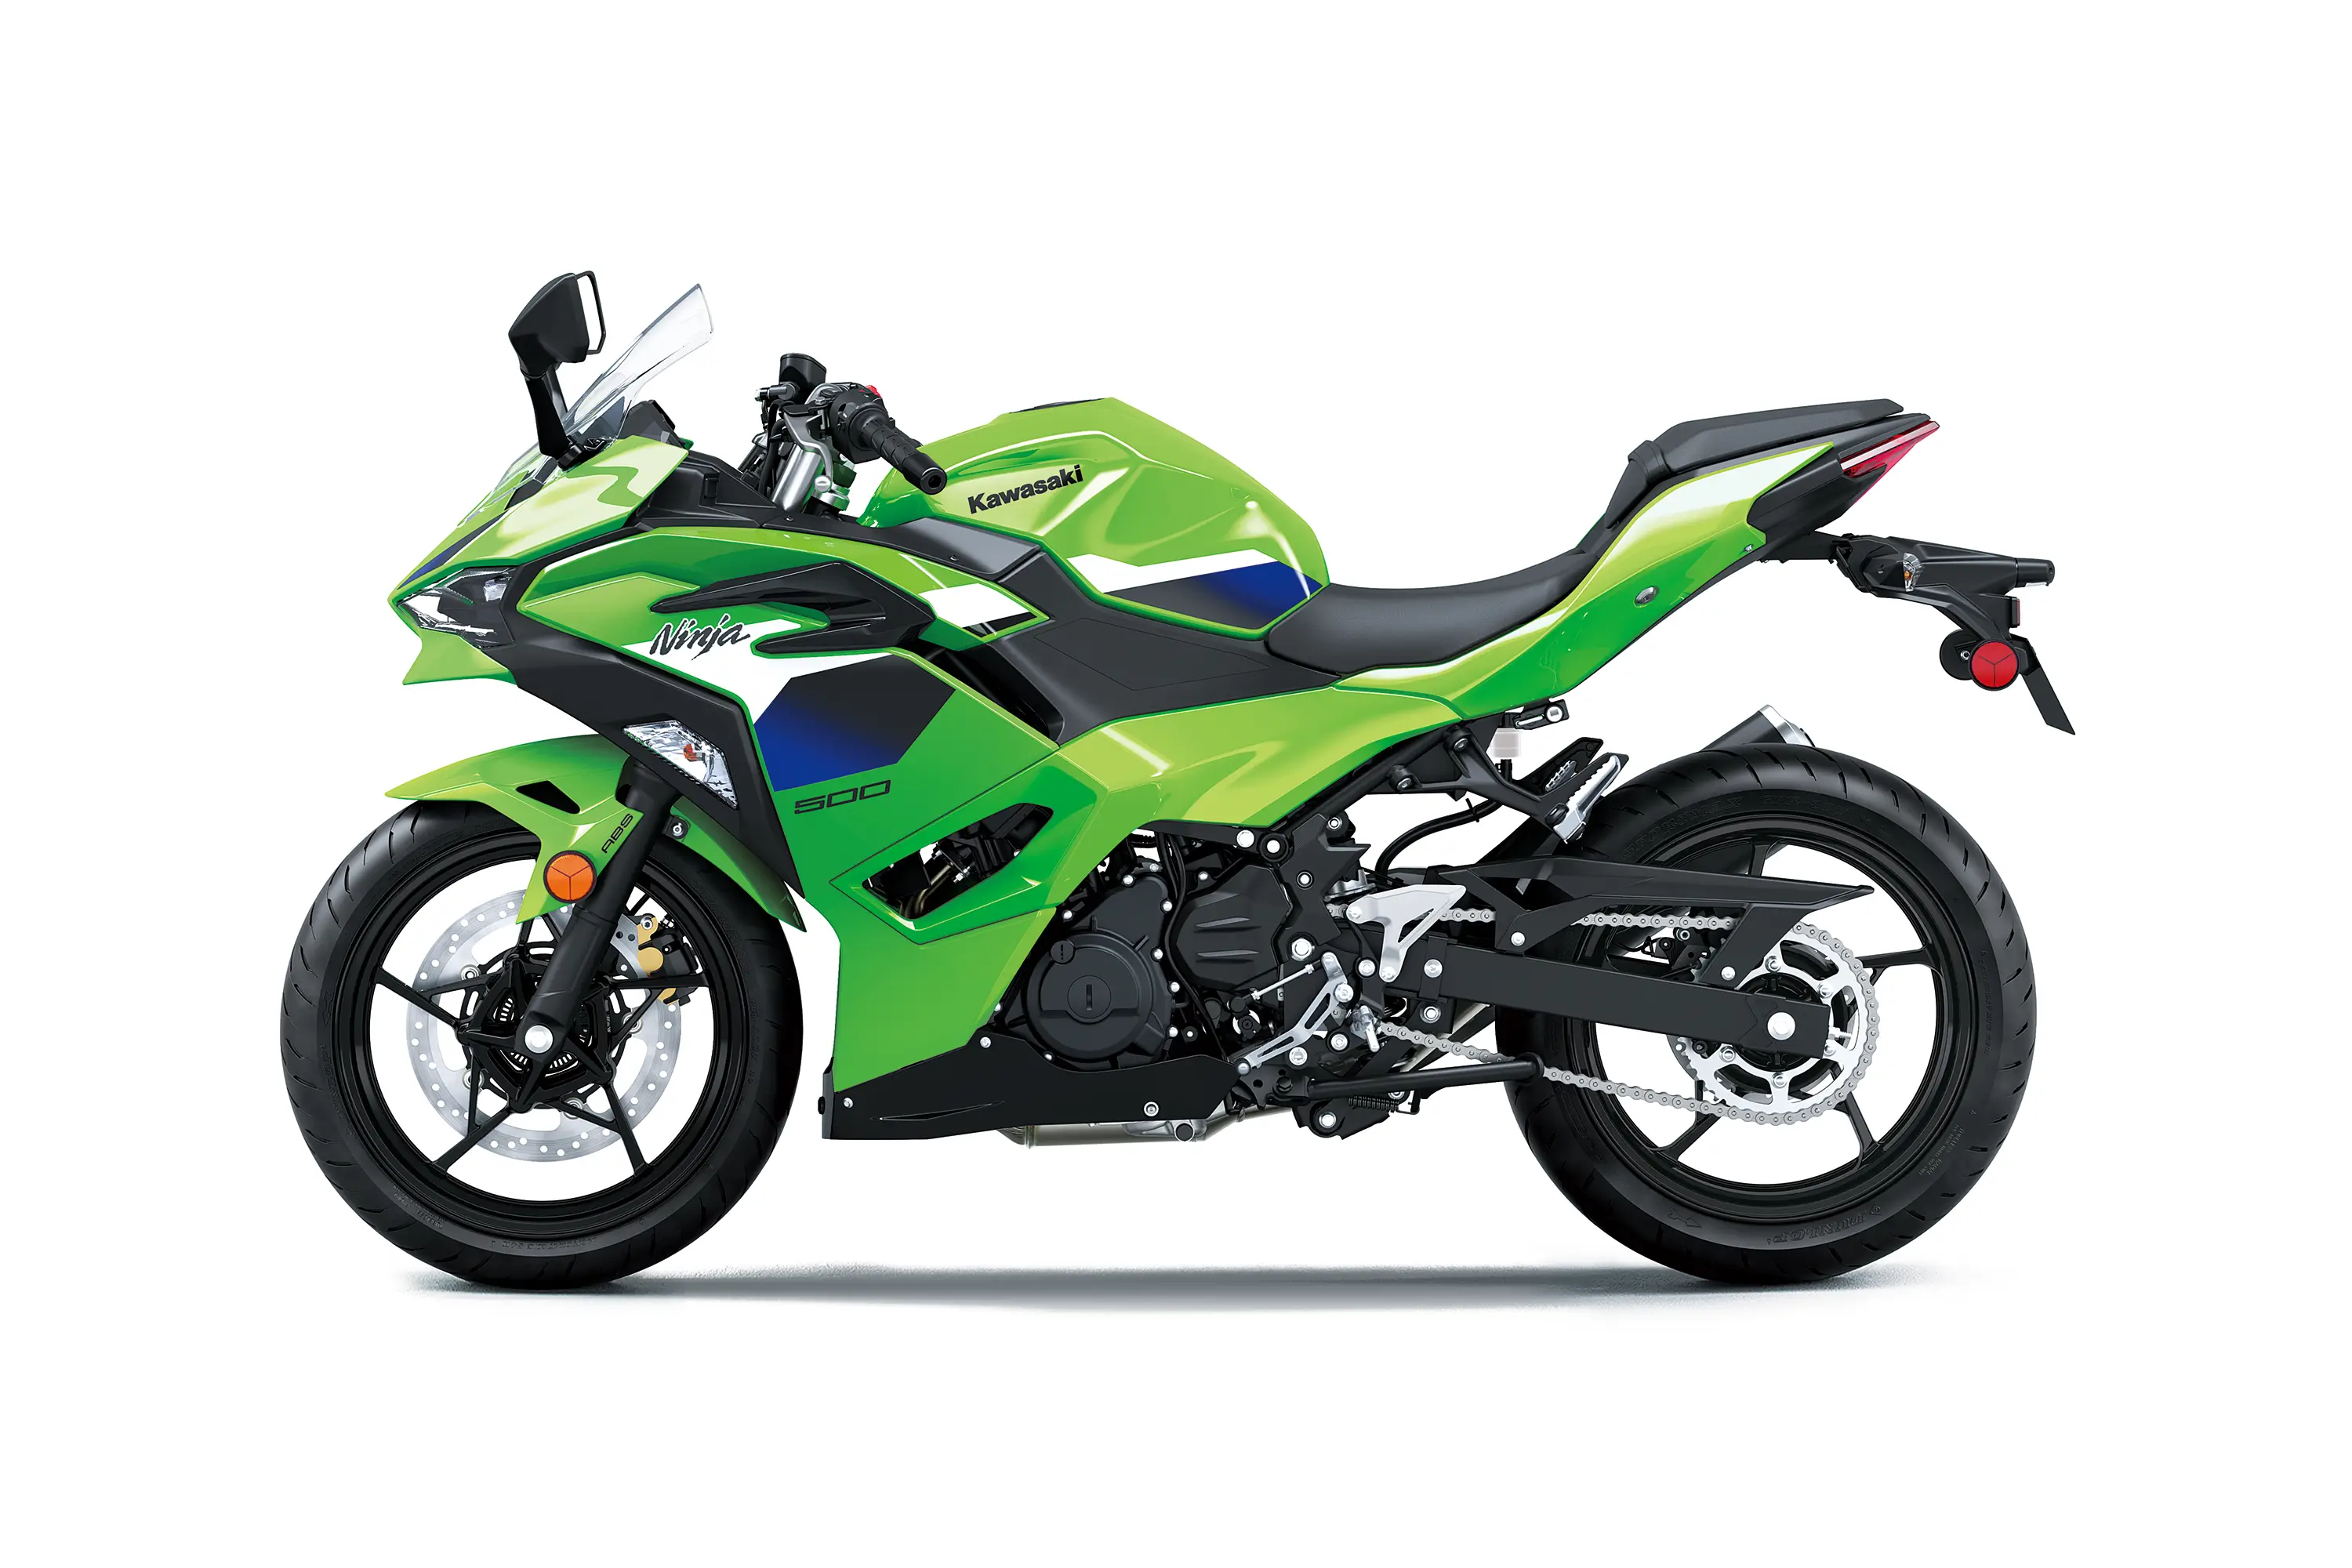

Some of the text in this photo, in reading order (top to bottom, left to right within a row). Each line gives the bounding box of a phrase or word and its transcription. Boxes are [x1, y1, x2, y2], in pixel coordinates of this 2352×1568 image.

[967, 464, 1083, 514] Kawasaki
[649, 615, 751, 660] Ninja
[794, 779, 891, 815] 500
[601, 813, 633, 854] ABS
